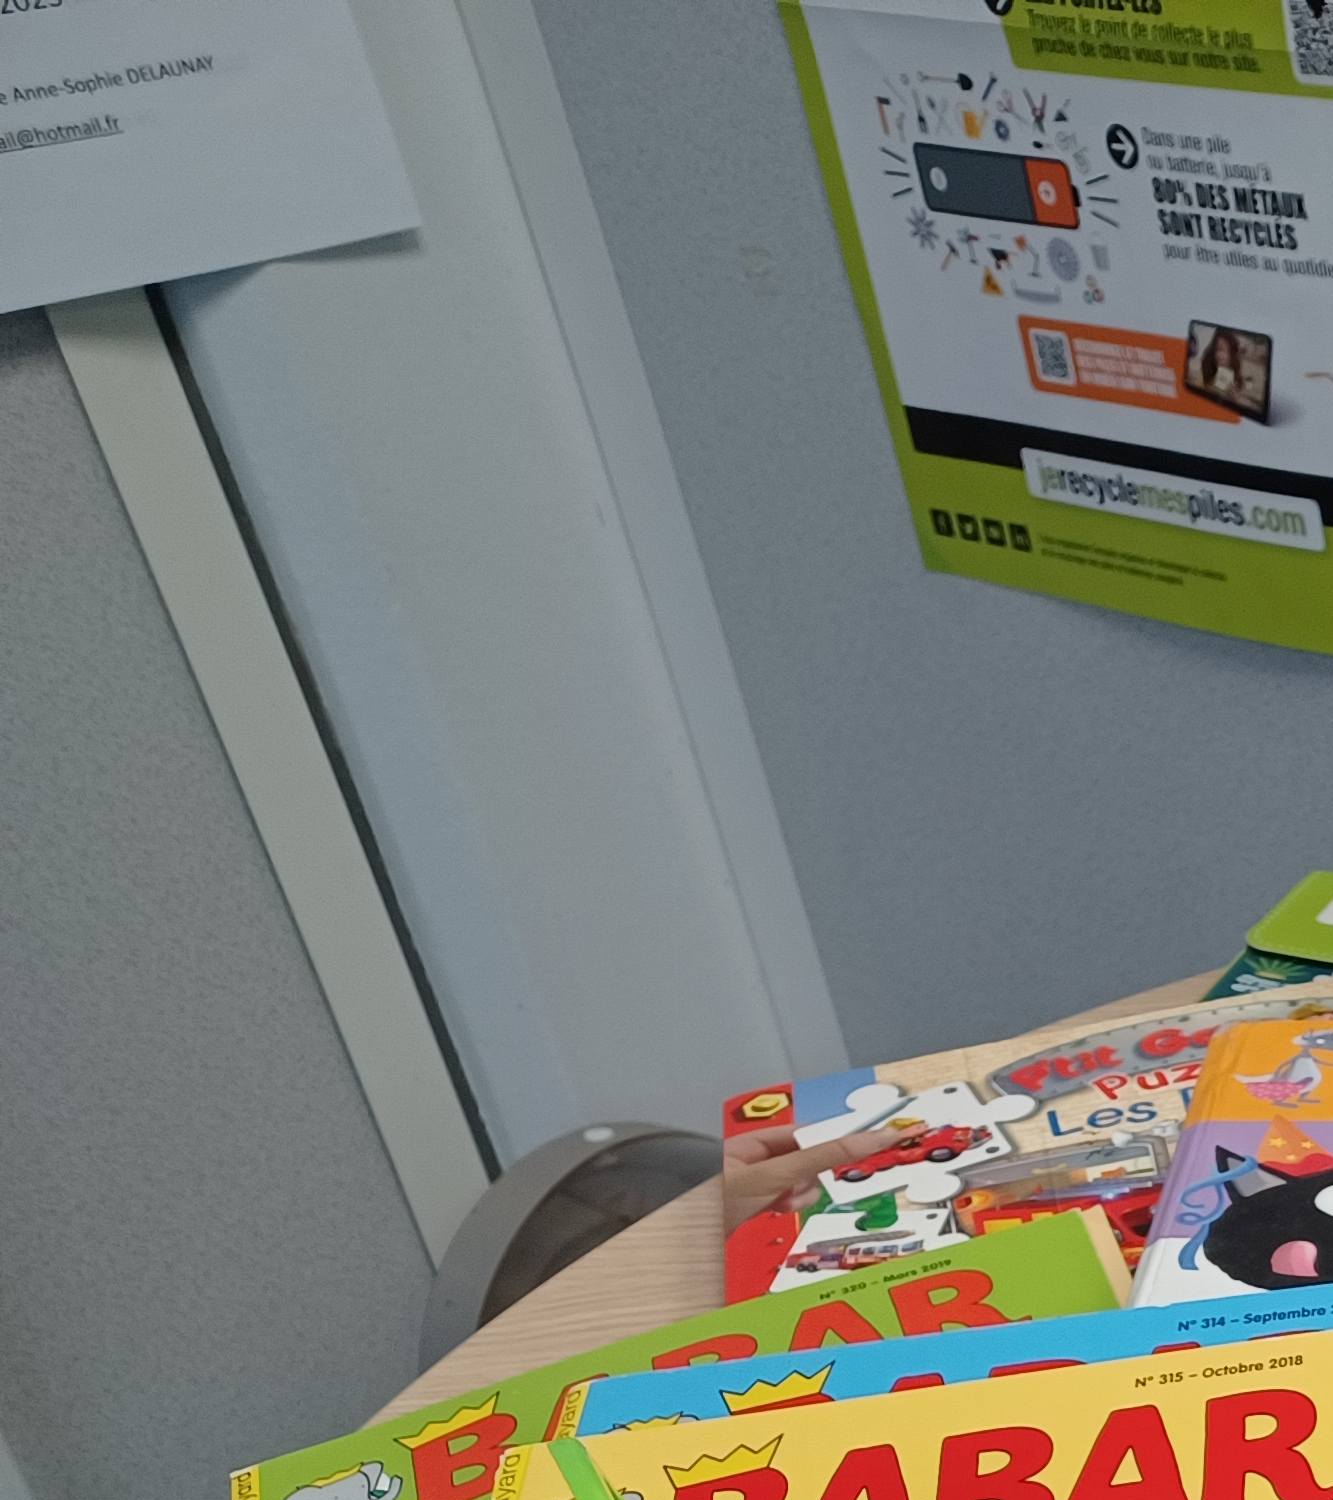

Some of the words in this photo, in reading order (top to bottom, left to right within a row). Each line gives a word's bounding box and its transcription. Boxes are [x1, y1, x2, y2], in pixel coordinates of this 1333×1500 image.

[1079, 16, 1093, 37] le
[1095, 19, 1129, 40] point
[1132, 20, 1149, 40] de
[1152, 22, 1205, 46] collecte
[1207, 25, 1221, 47] le
[1223, 29, 1254, 50] plus
[1081, 40, 1098, 57] de
[1099, 41, 1131, 62] chez
[1168, 50, 1189, 67] sur
[13, 72, 125, 103] Anne-Sophie
[126, 55, 215, 86] DELAUNAY
[1141, 126, 1175, 148] Dans
[1181, 133, 1202, 150] une
[1206, 134, 1232, 154] pile
[1152, 176, 1193, 206] 80%
[1195, 182, 1231, 212] DES
[1232, 183, 1308, 220] MÉTAUX
[1157, 208, 1204, 239] SONT
[1208, 214, 1299, 250] RECYCLÉS
[1163, 244, 1192, 262] pour
[1196, 244, 1219, 265] être
[1224, 249, 1259, 271] utiles
[1036, 457, 1310, 537] jerecyclemespiles.com
[1009, 1045, 1125, 1093] P'tit
[1047, 1102, 1157, 1136] Les
[836, 1282, 869, 1299] 320
[883, 1267, 917, 1286] Mars
[918, 1260, 952, 1277] 2019
[1201, 1316, 1228, 1330] 314
[1243, 1305, 1328, 1327] Septembre
[1159, 1371, 1185, 1387] 315
[1202, 1361, 1265, 1382] Octobre
[1268, 1354, 1306, 1371] 2018
